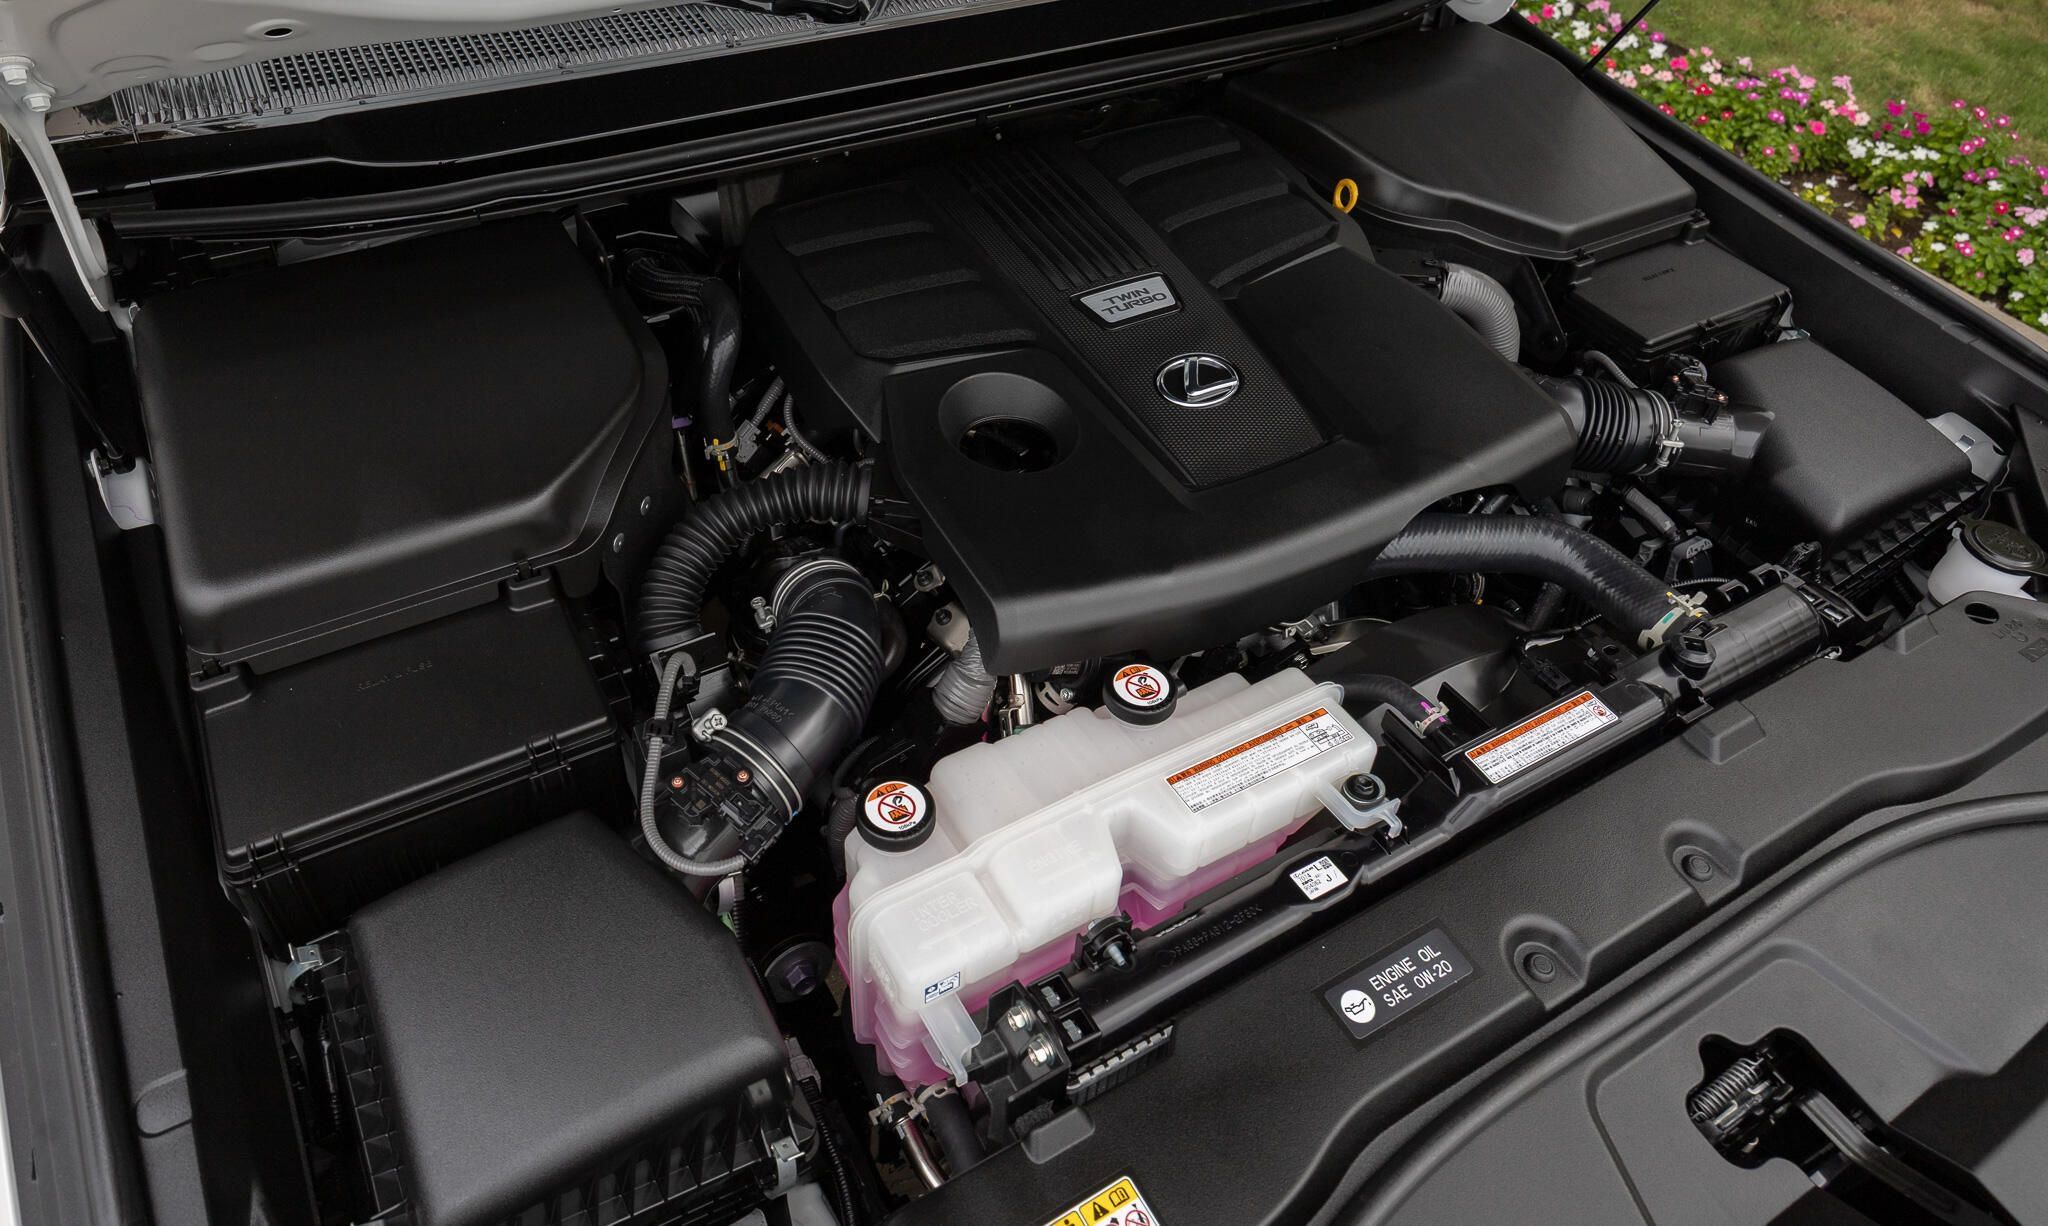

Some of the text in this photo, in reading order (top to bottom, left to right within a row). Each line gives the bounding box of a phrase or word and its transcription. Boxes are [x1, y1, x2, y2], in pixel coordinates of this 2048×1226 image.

[1101, 292, 1167, 315] TURBO
[1102, 287, 1149, 304] TWIN
[912, 891, 957, 921] INTER
[919, 897, 979, 932] COOLER
[1369, 945, 1442, 991] ENGINE OIL
[1383, 960, 1453, 1007] SAE 0W-20
